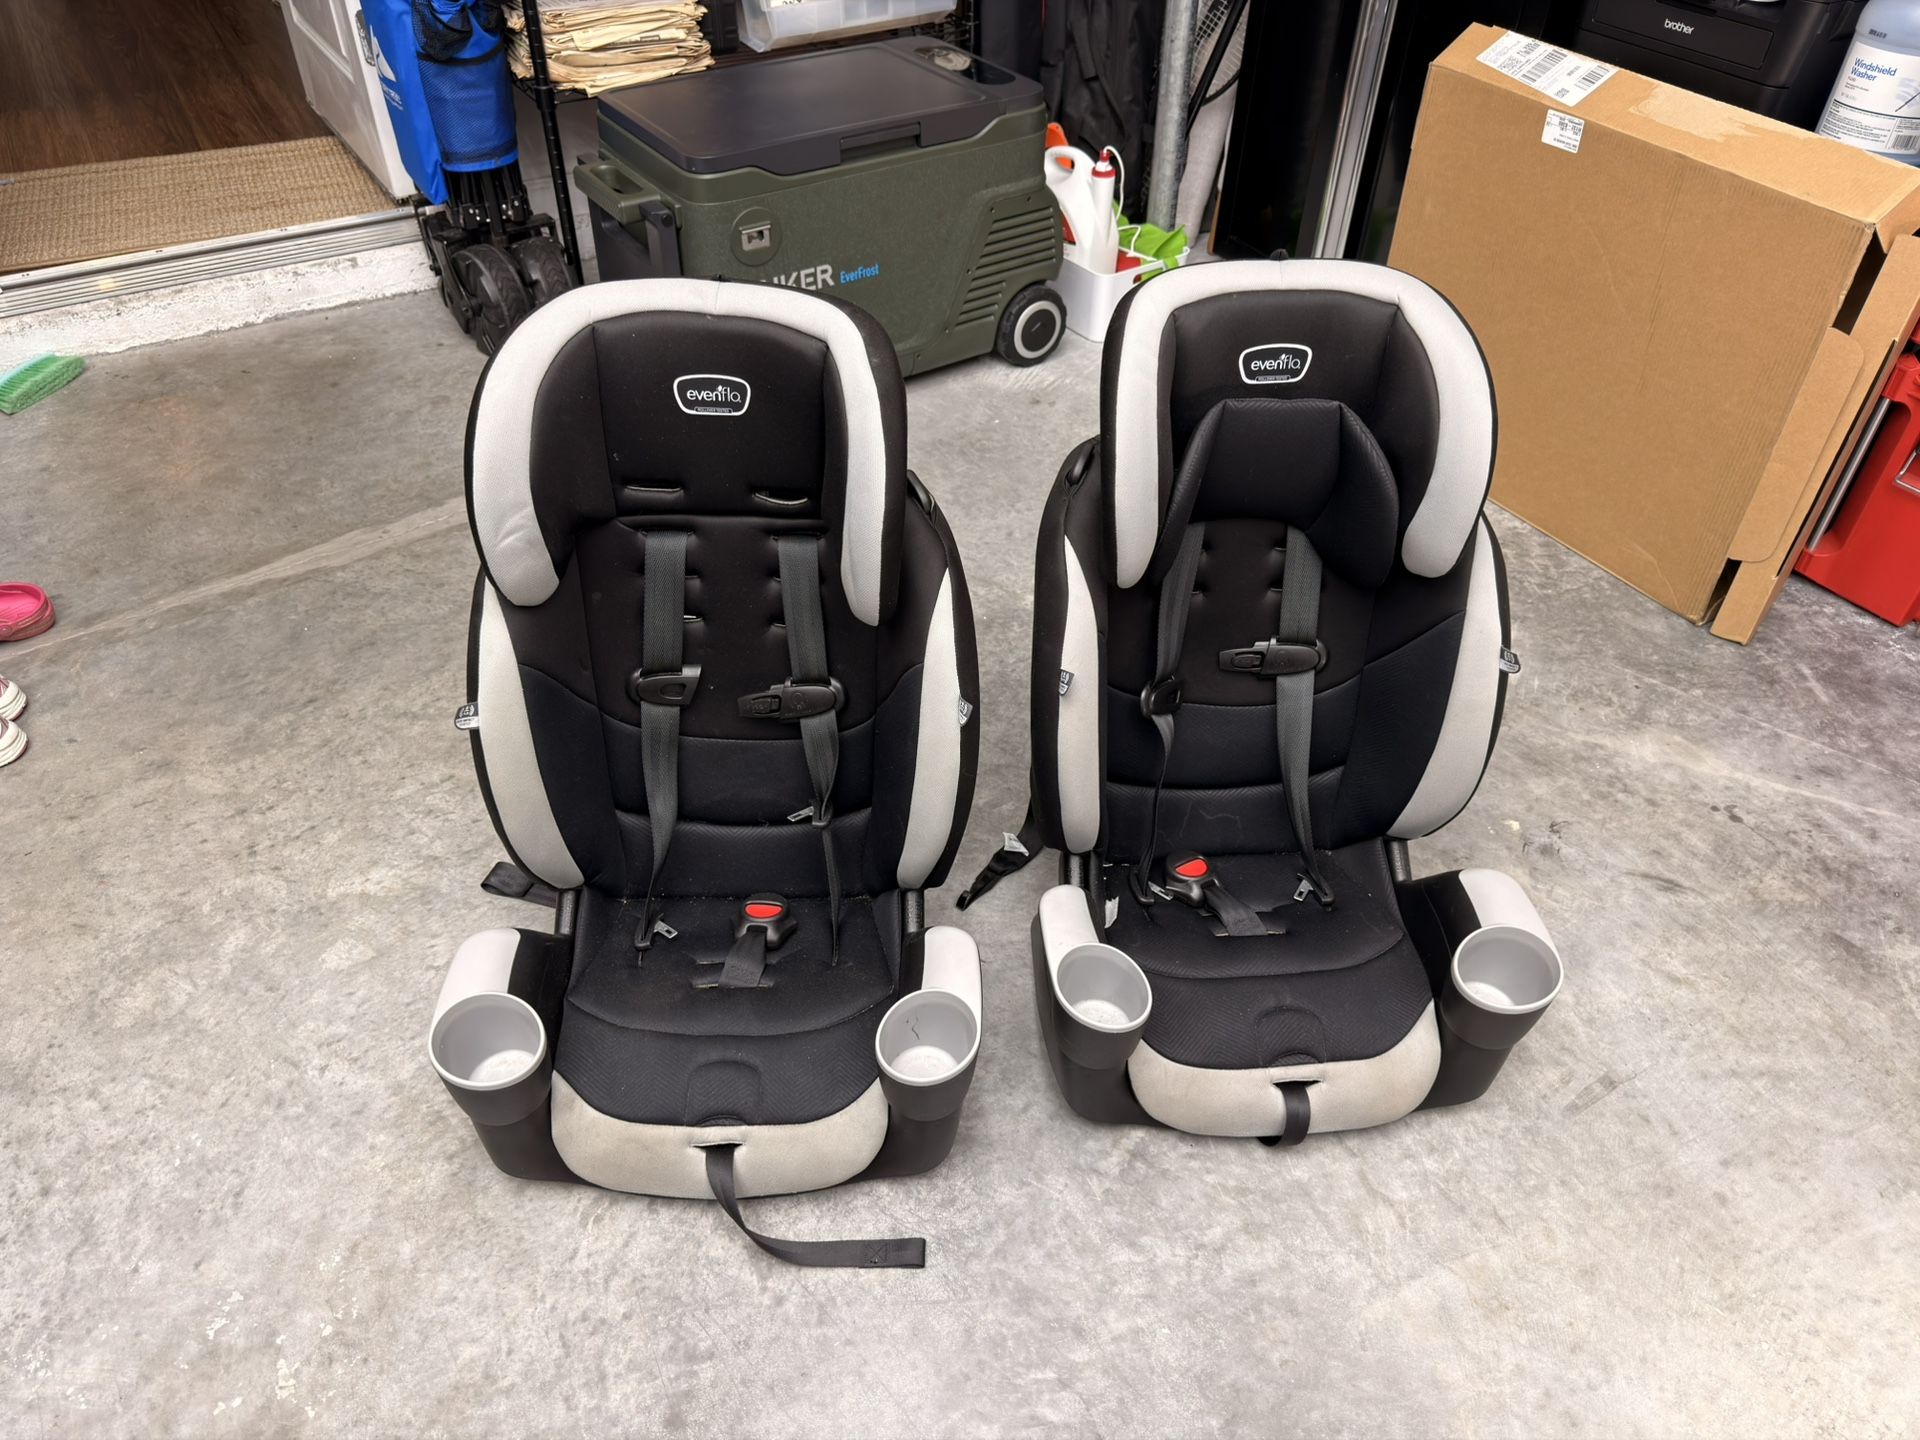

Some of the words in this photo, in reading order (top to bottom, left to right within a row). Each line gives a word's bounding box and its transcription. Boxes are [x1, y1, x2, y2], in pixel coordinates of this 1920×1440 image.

[1664, 18, 1694, 35] brother
[1850, 66, 1878, 81] Washer
[1854, 57, 1898, 77] Windshield
[840, 263, 880, 284] EverFrost
[1250, 353, 1301, 371] evenflo
[686, 385, 741, 403] evenflo
